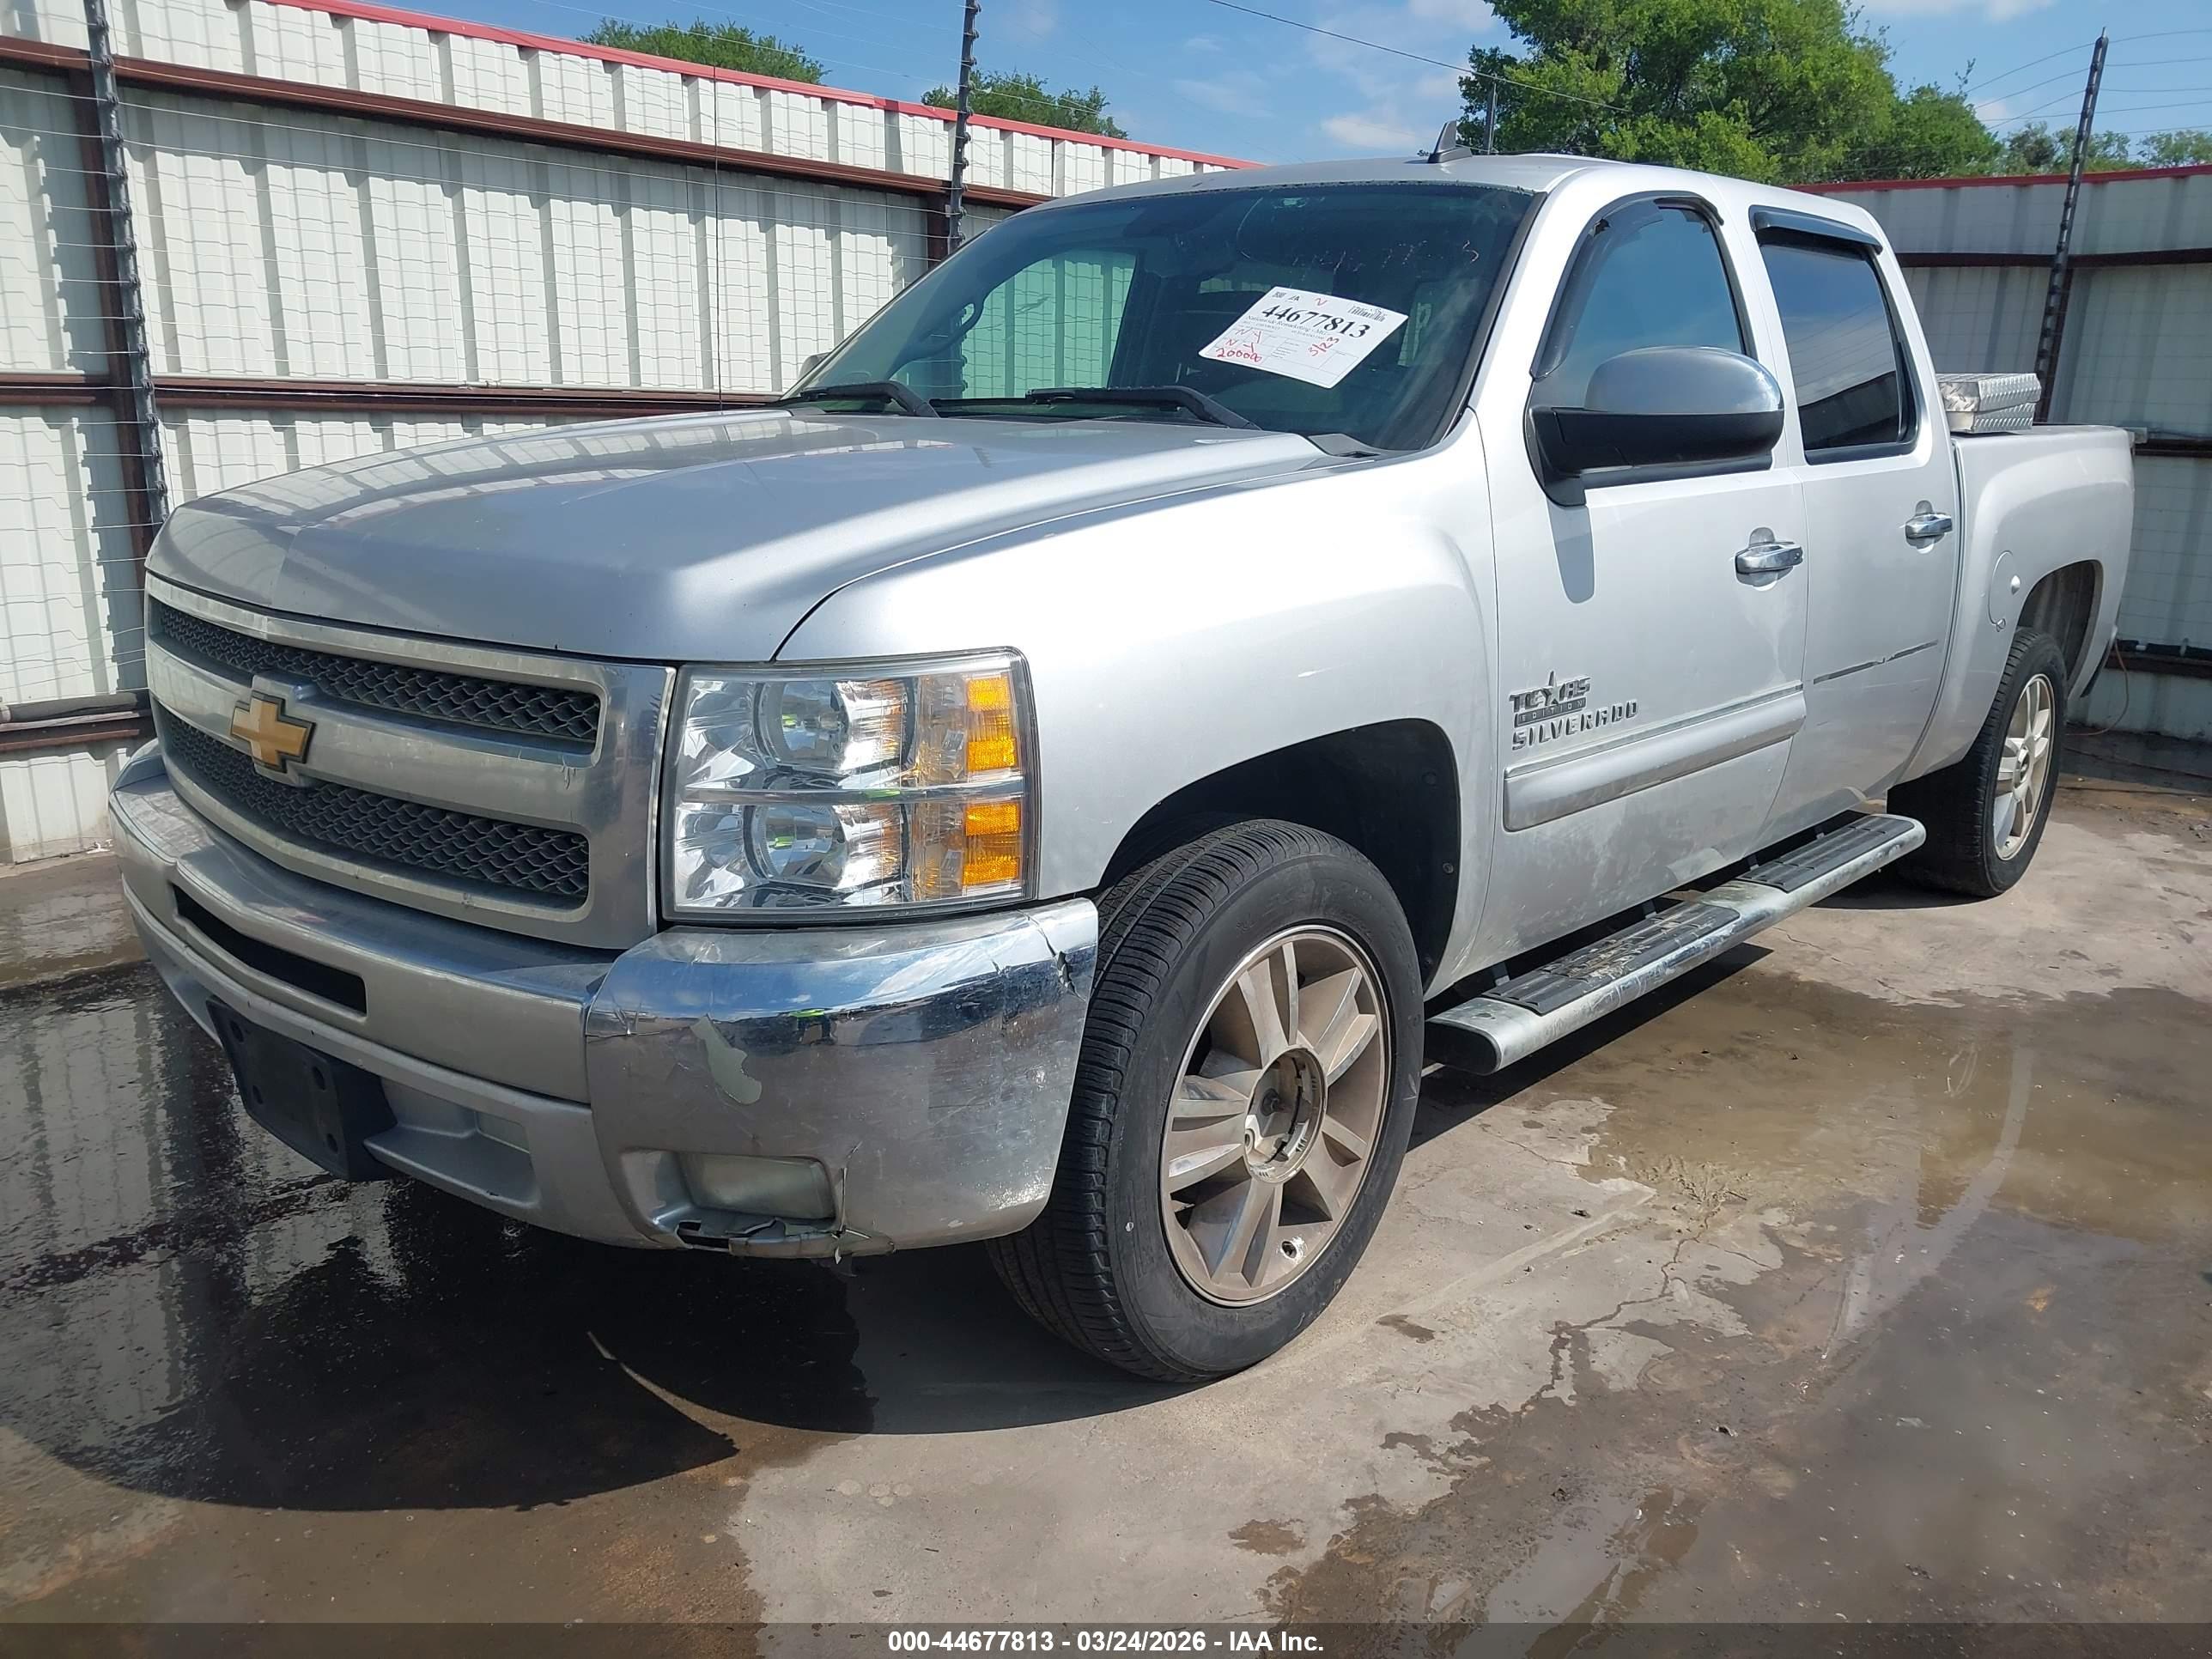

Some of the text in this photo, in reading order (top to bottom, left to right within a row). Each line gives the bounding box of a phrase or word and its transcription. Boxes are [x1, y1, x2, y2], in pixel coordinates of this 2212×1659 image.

[1261, 304, 1371, 338] 44677813
[1509, 676, 1591, 713] TEXAS
[1518, 700, 1586, 723] EDITION
[1512, 699, 1638, 750] SILVERADO
